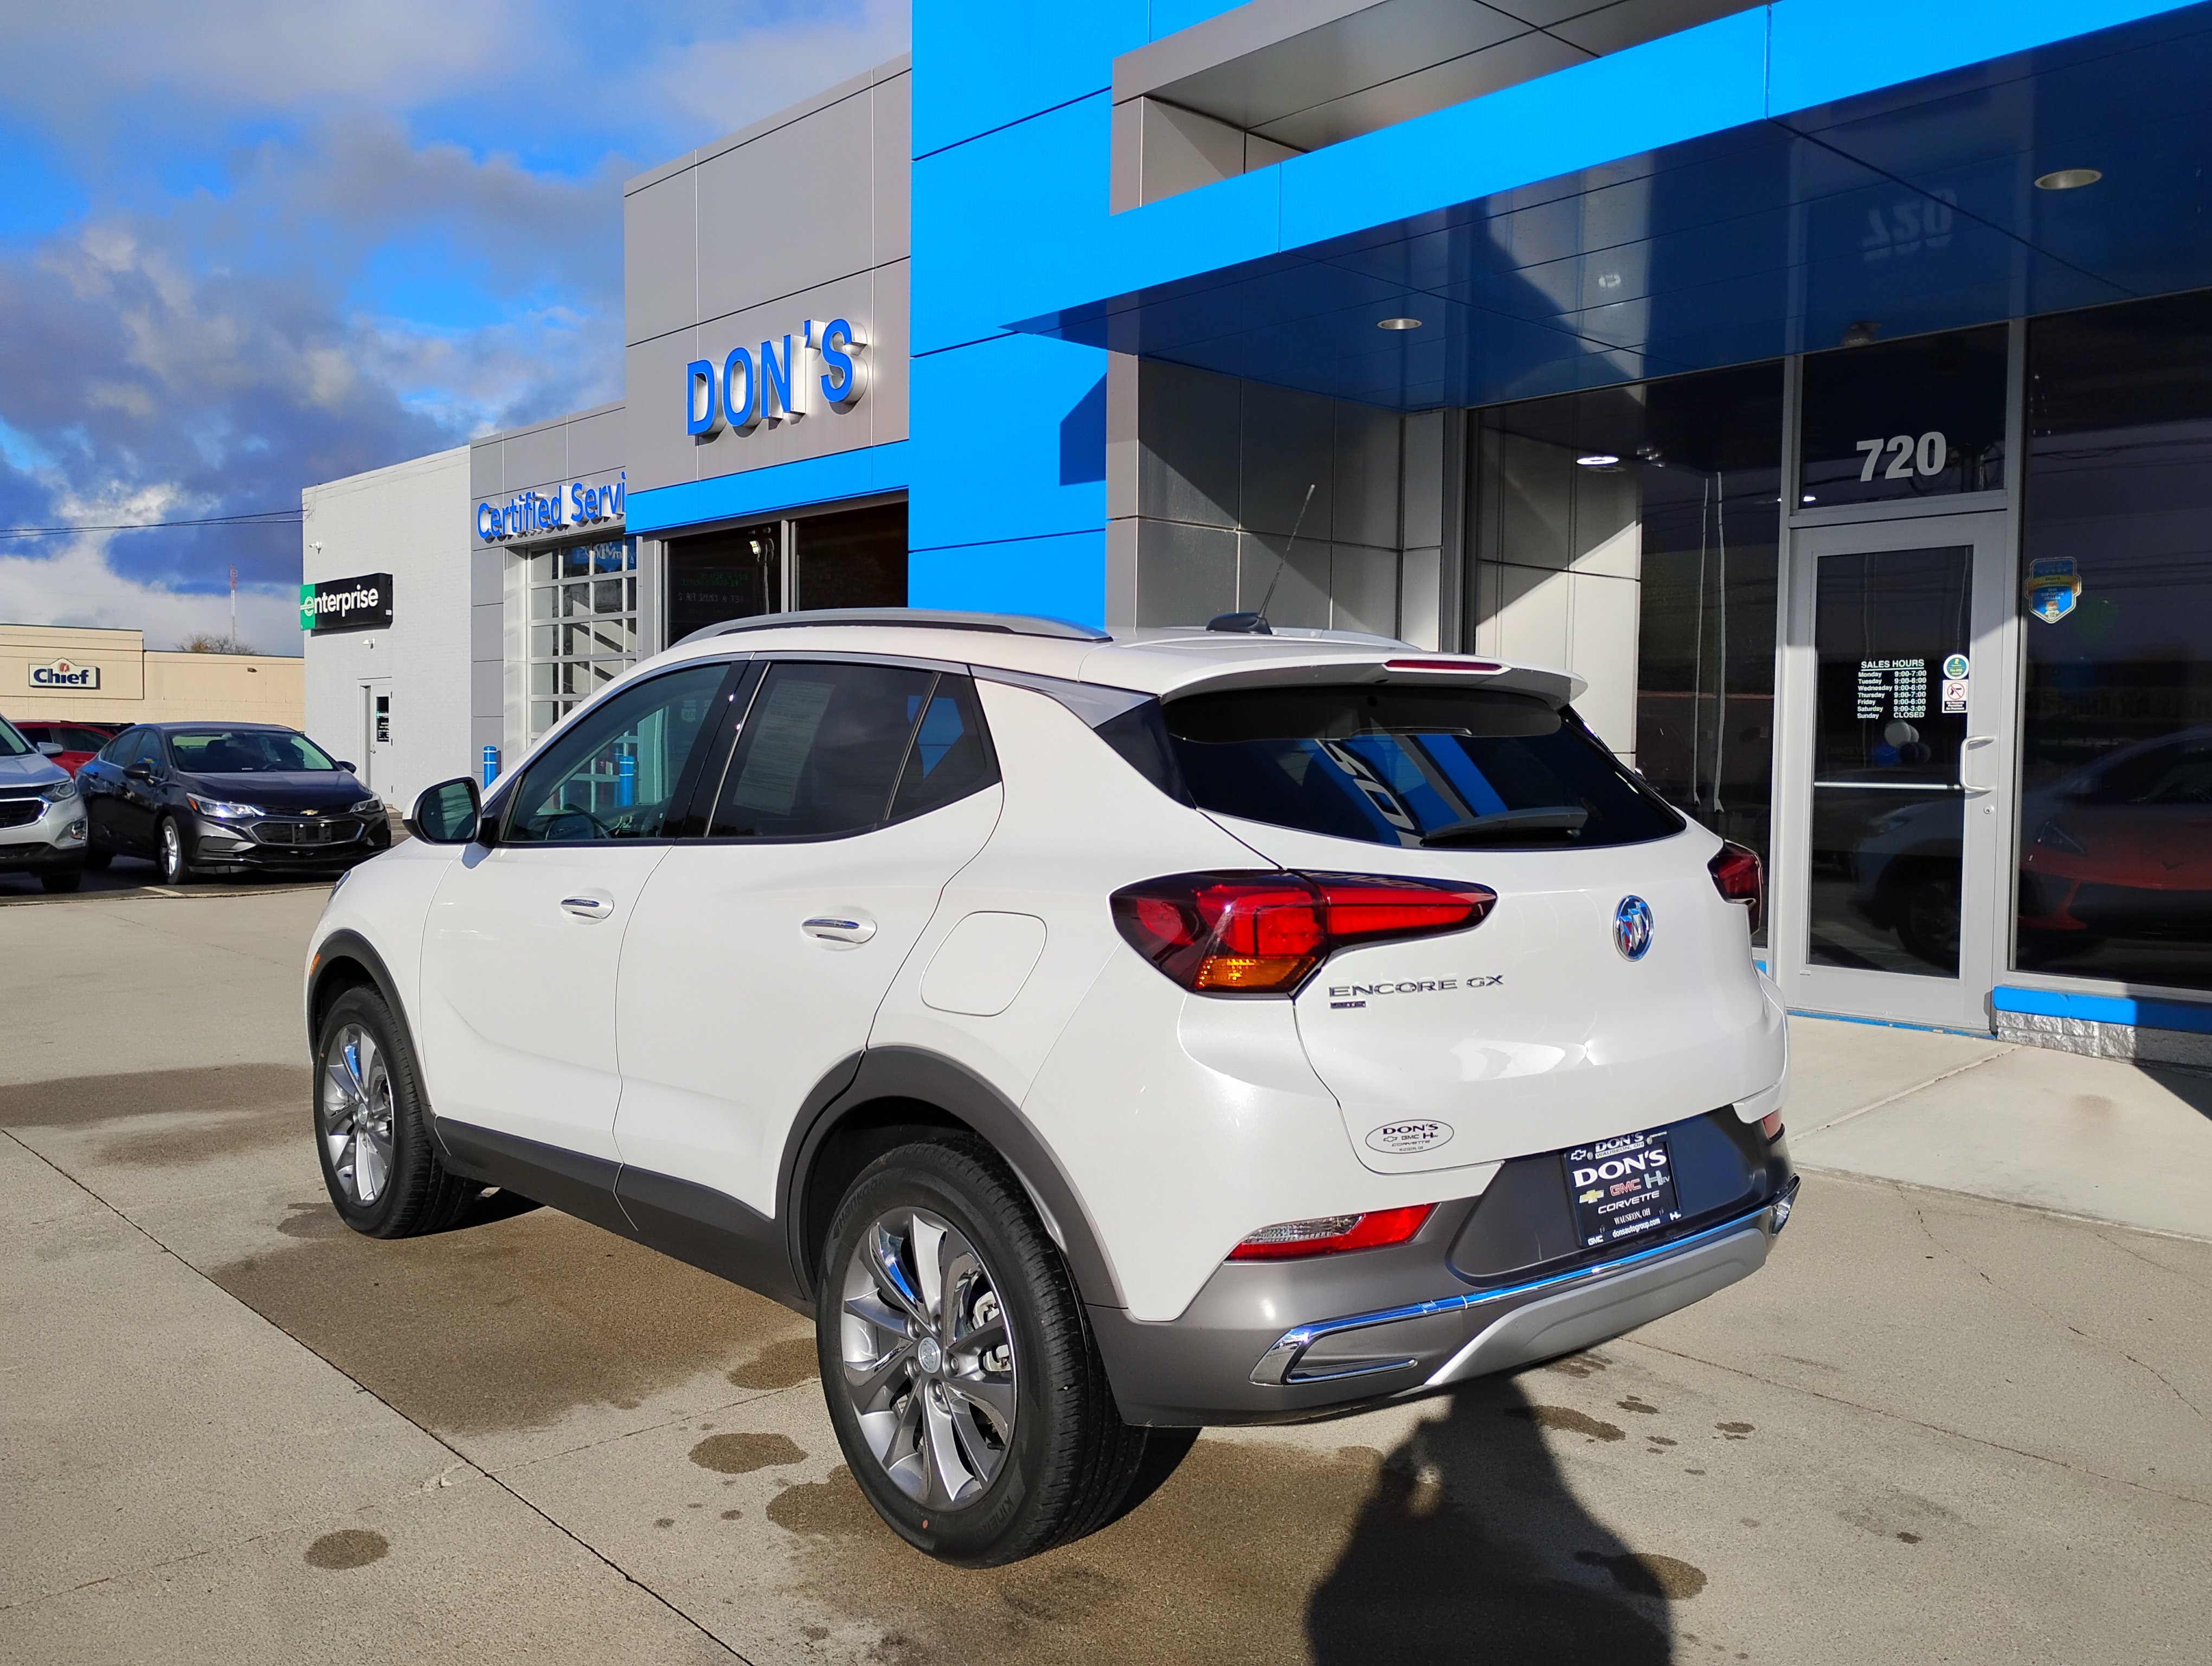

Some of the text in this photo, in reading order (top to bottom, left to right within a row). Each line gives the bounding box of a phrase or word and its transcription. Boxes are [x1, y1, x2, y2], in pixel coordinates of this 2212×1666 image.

[686, 318, 859, 436] DON'S
[1856, 431, 1946, 482] 720
[478, 471, 626, 539] Certified Servi
[300, 584, 378, 617] enterprise
[1861, 659, 1925, 669] SALES HOURS
[34, 669, 89, 684] Chief
[1328, 975, 1504, 997] ENCORE GX
[1382, 1123, 1438, 1135] DON'S
[1595, 1132, 1644, 1153] DON'S
[1596, 1145, 1632, 1157] WAUSEON,
[1572, 1149, 1667, 1188] DON'S
[1610, 1178, 1642, 1196] GMC
[1598, 1190, 1660, 1214] CORVETTE
[1613, 1208, 1651, 1225] WAUSEON, OH
[1612, 1218, 1661, 1238] donsautogroup.com
[1587, 1235, 1604, 1246] GMC
